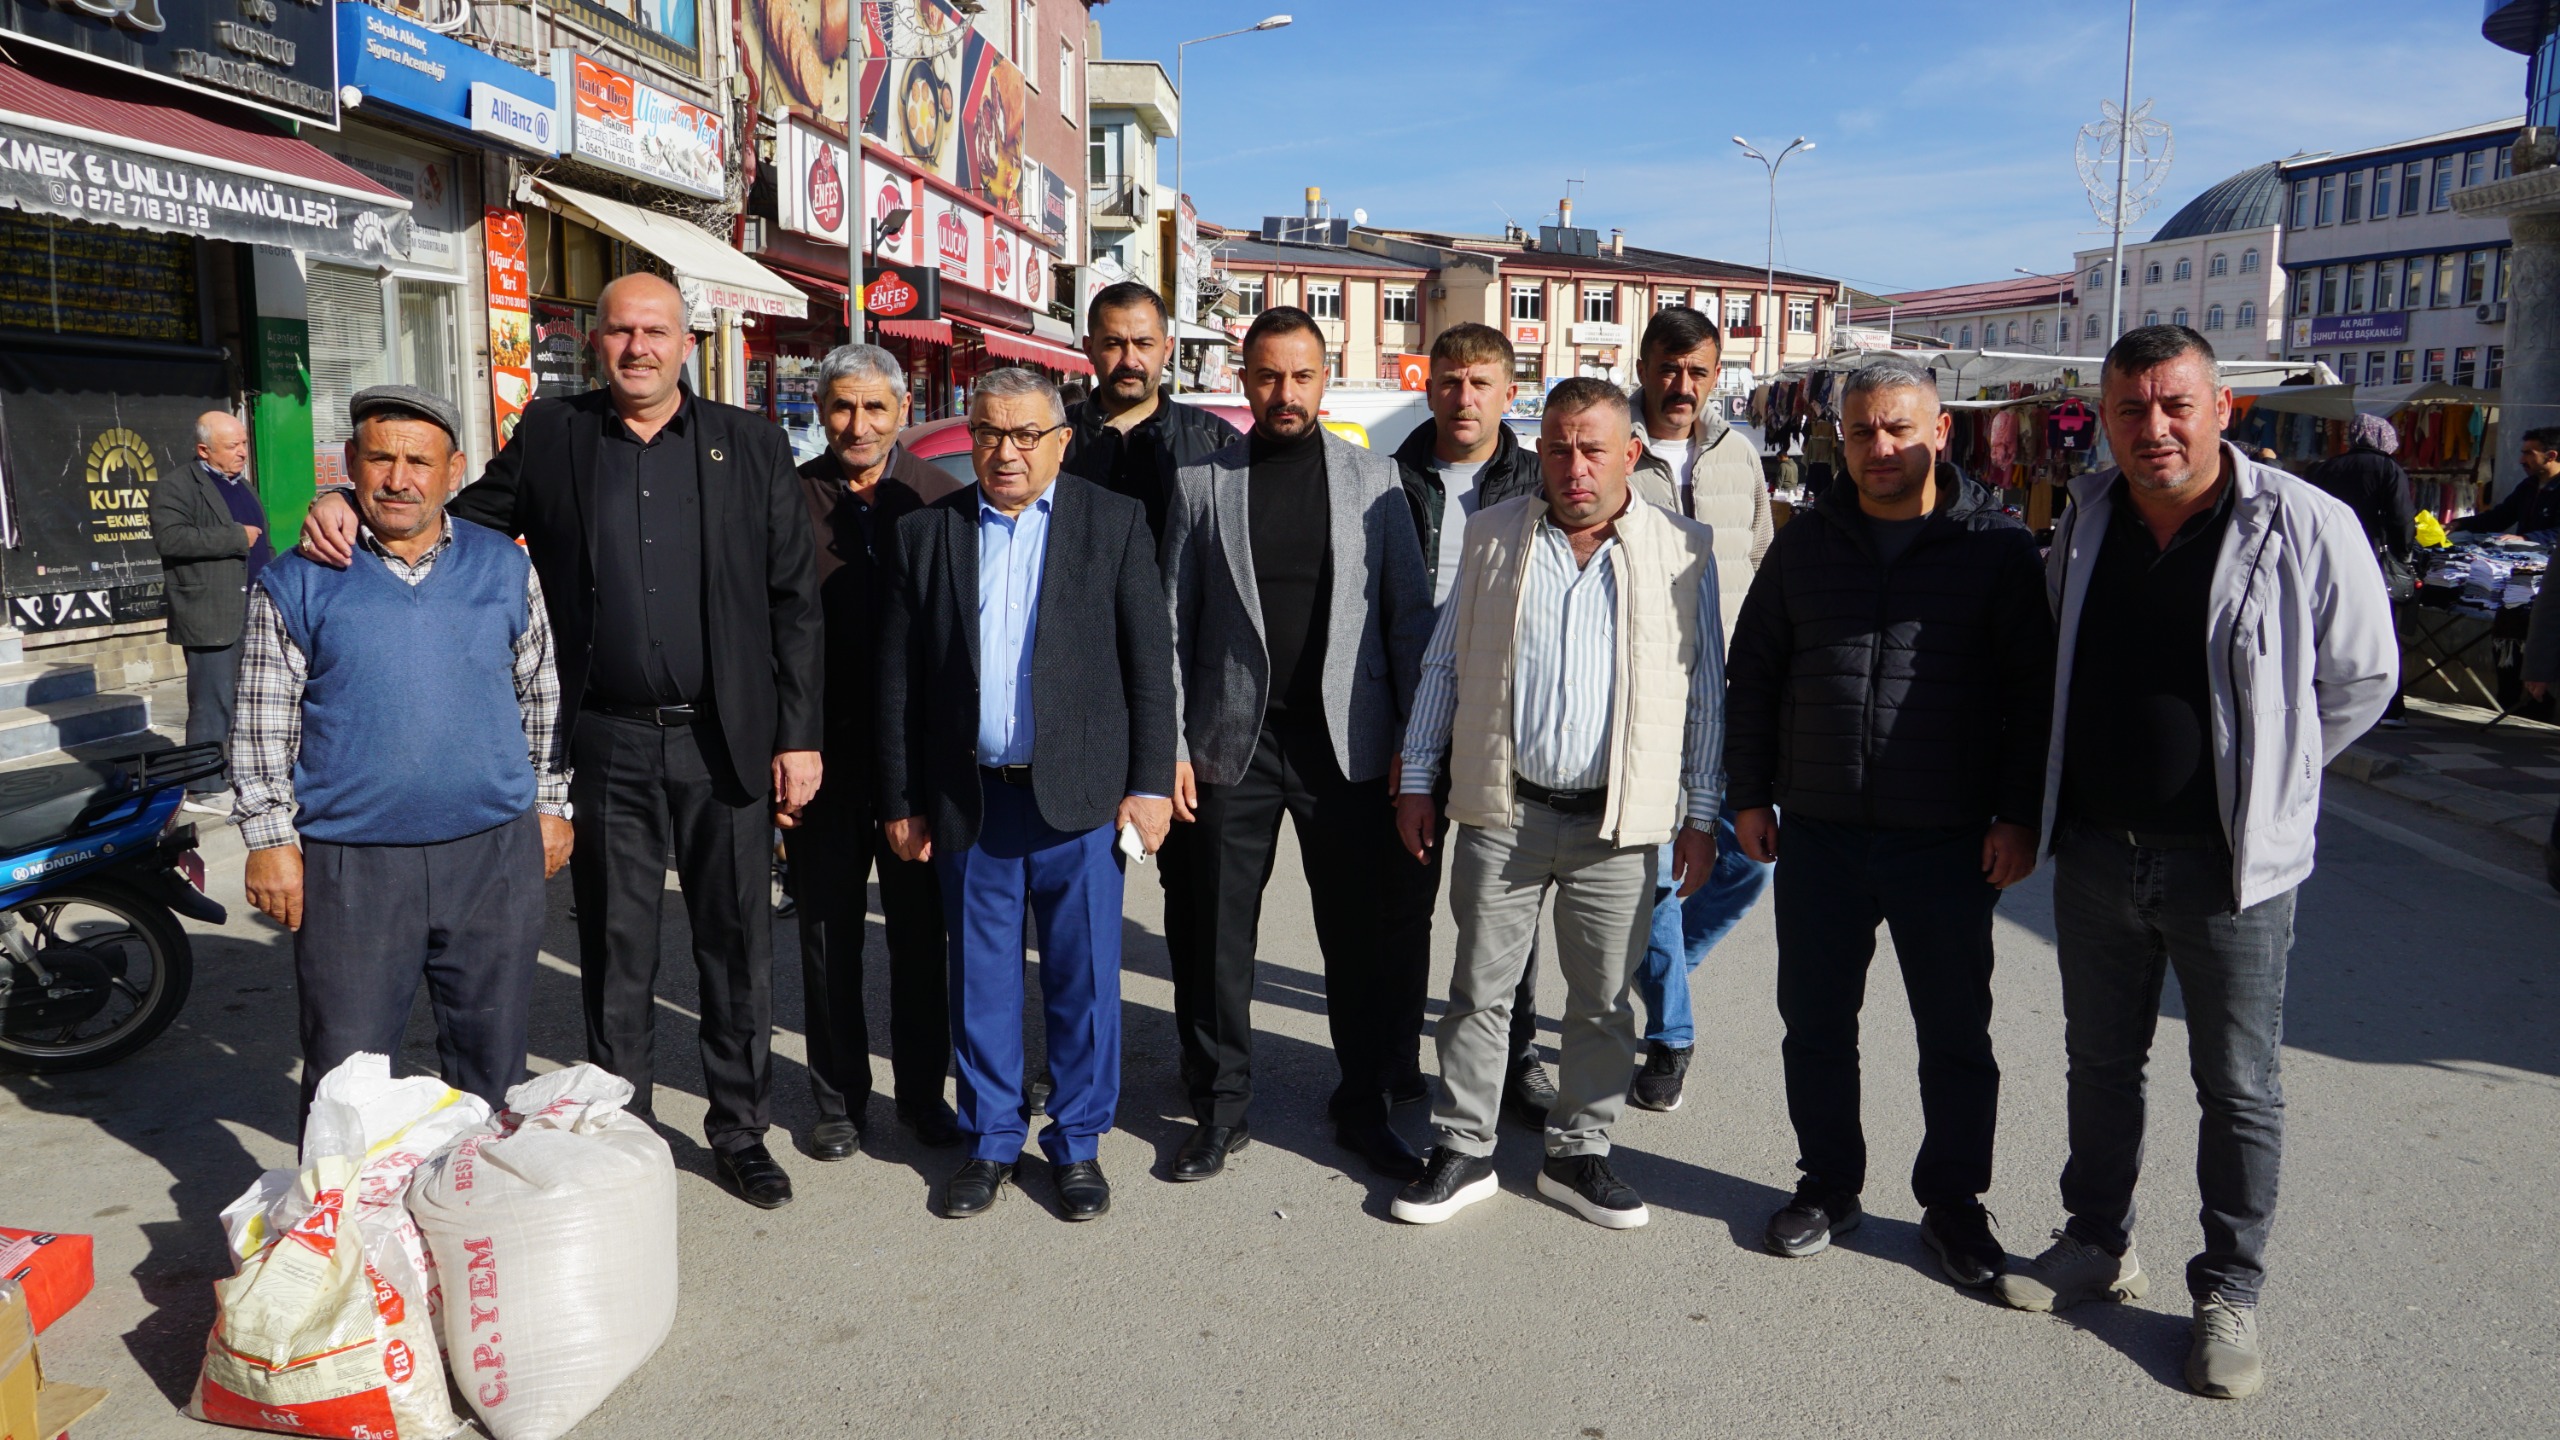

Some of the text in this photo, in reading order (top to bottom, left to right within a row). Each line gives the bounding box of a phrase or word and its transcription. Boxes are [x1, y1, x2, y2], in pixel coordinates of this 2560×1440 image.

[219, 21, 296, 66] UNLU
[366, 16, 427, 55] Selçuk Akkoç
[366, 38, 446, 81] Sigorta Acenteliği
[491, 98, 532, 133] Allianz
[696, 110, 720, 152] Yeri
[586, 142, 602, 155] 0543
[70, 185, 210, 229] 0 272 718 31 33
[84, 155, 106, 185] &
[112, 160, 187, 199] UNLU
[196, 178, 339, 229] MAMÜLLERİ
[814, 181, 838, 208] ENFES
[939, 225, 967, 258] ULUÇAY
[871, 287, 909, 307] ENFES
[875, 285, 884, 294] ET
[2312, 326, 2402, 343] ŞUHUT İLÇE BAŞKANLIĞI
[2340, 317, 2374, 328] AK PARTİ
[93, 532, 119, 543] UNLU
[29, 849, 96, 877] MONDIAL
[391, 1341, 412, 1383] tat
[260, 1408, 304, 1427] tat
